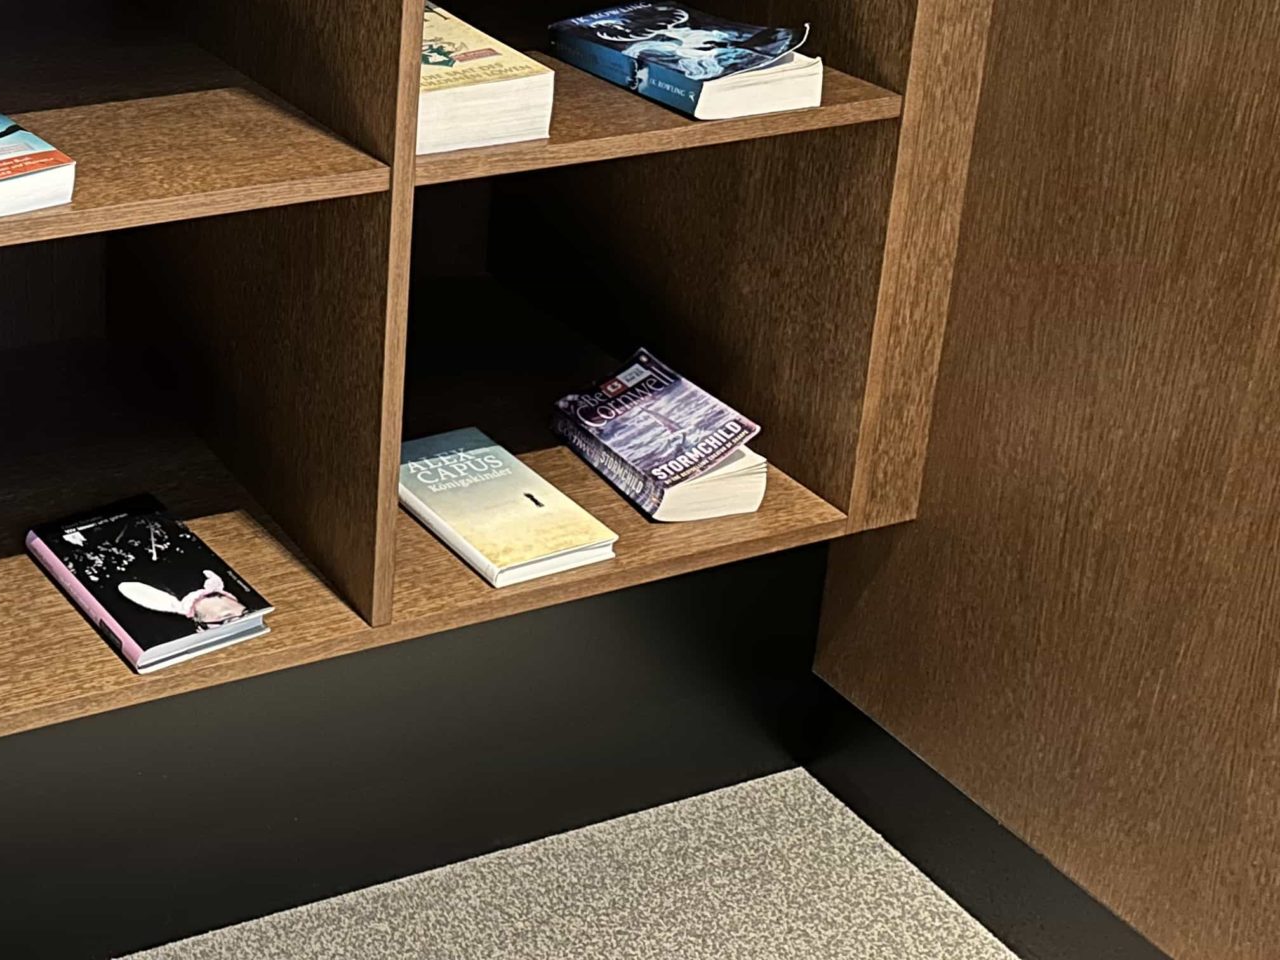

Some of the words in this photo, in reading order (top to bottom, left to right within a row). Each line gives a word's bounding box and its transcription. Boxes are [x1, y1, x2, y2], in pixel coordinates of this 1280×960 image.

[577, 366, 675, 427] Cornwell
[408, 448, 475, 473] ALEX
[651, 421, 742, 480] STORMCHILD
[417, 455, 503, 483] CAPUS
[428, 467, 513, 492] Königskinder
[599, 450, 645, 495] STORMCHILD
